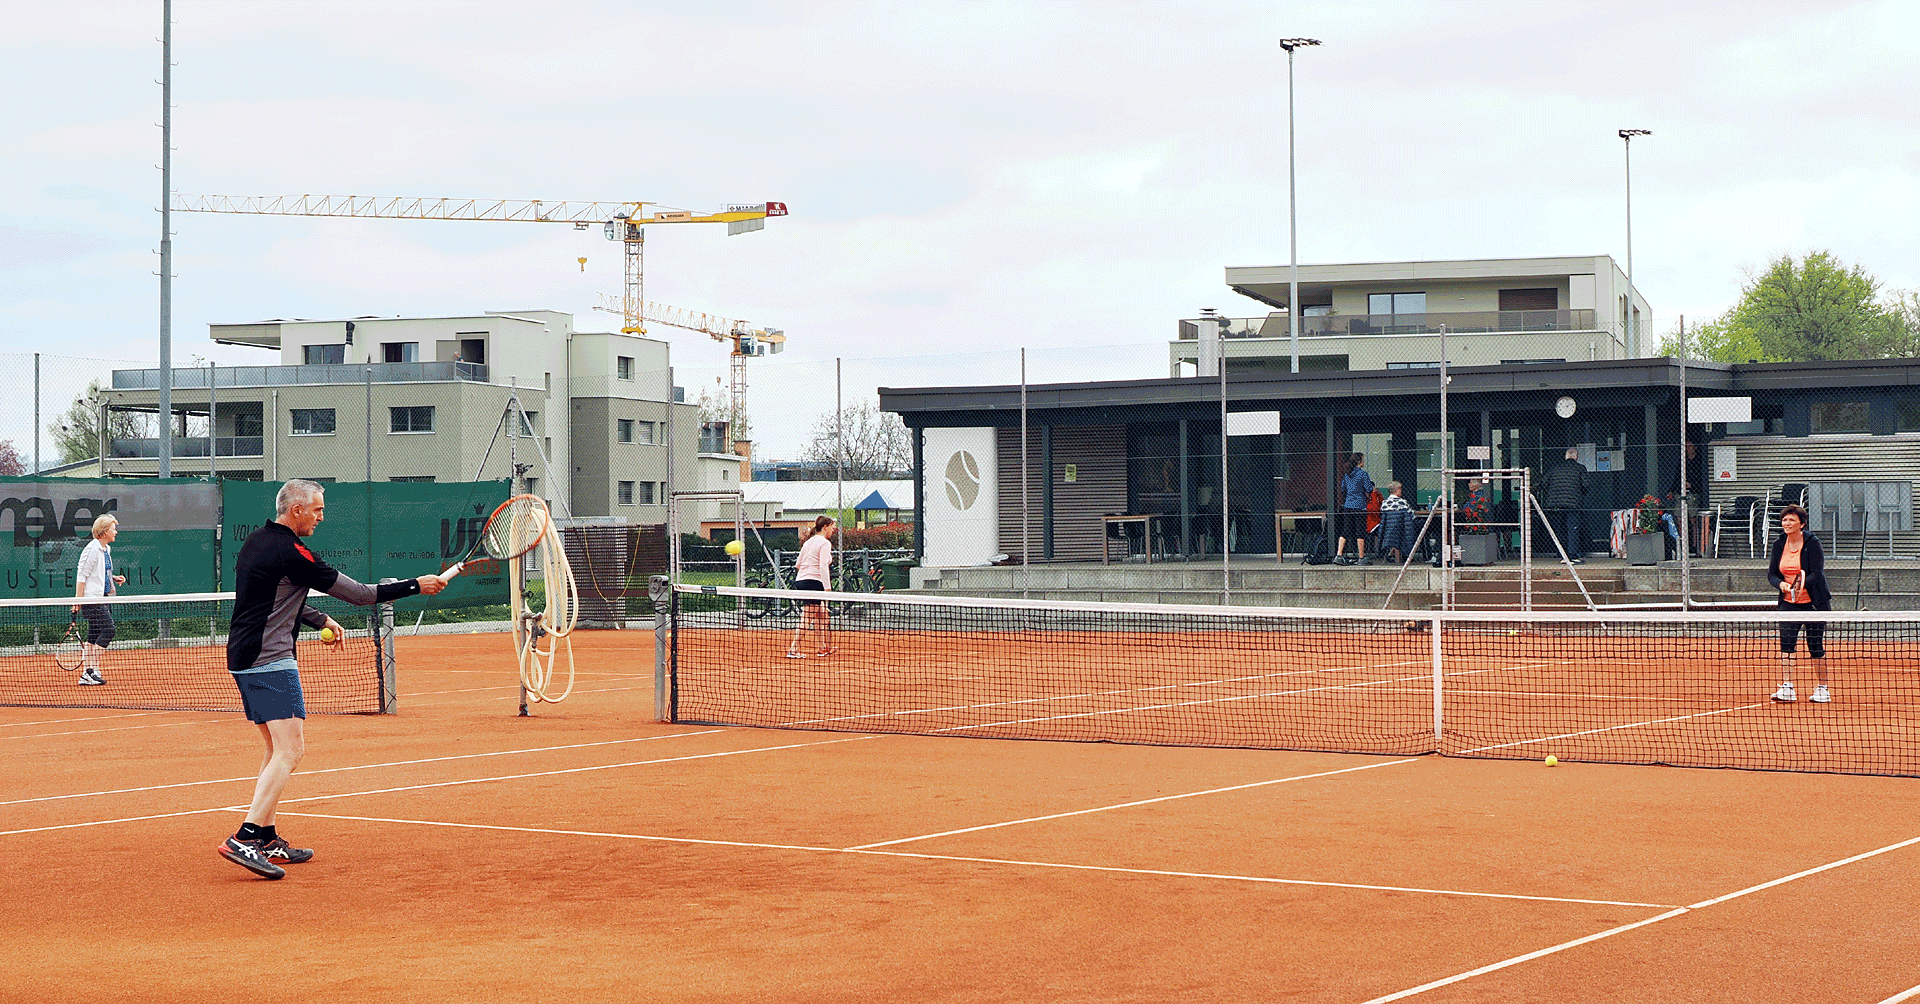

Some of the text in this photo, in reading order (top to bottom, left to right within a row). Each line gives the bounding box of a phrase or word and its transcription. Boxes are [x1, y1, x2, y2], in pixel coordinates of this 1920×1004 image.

[441, 517, 495, 558] VO
[7, 565, 162, 590] USTENIK
[441, 559, 501, 577] MROS
